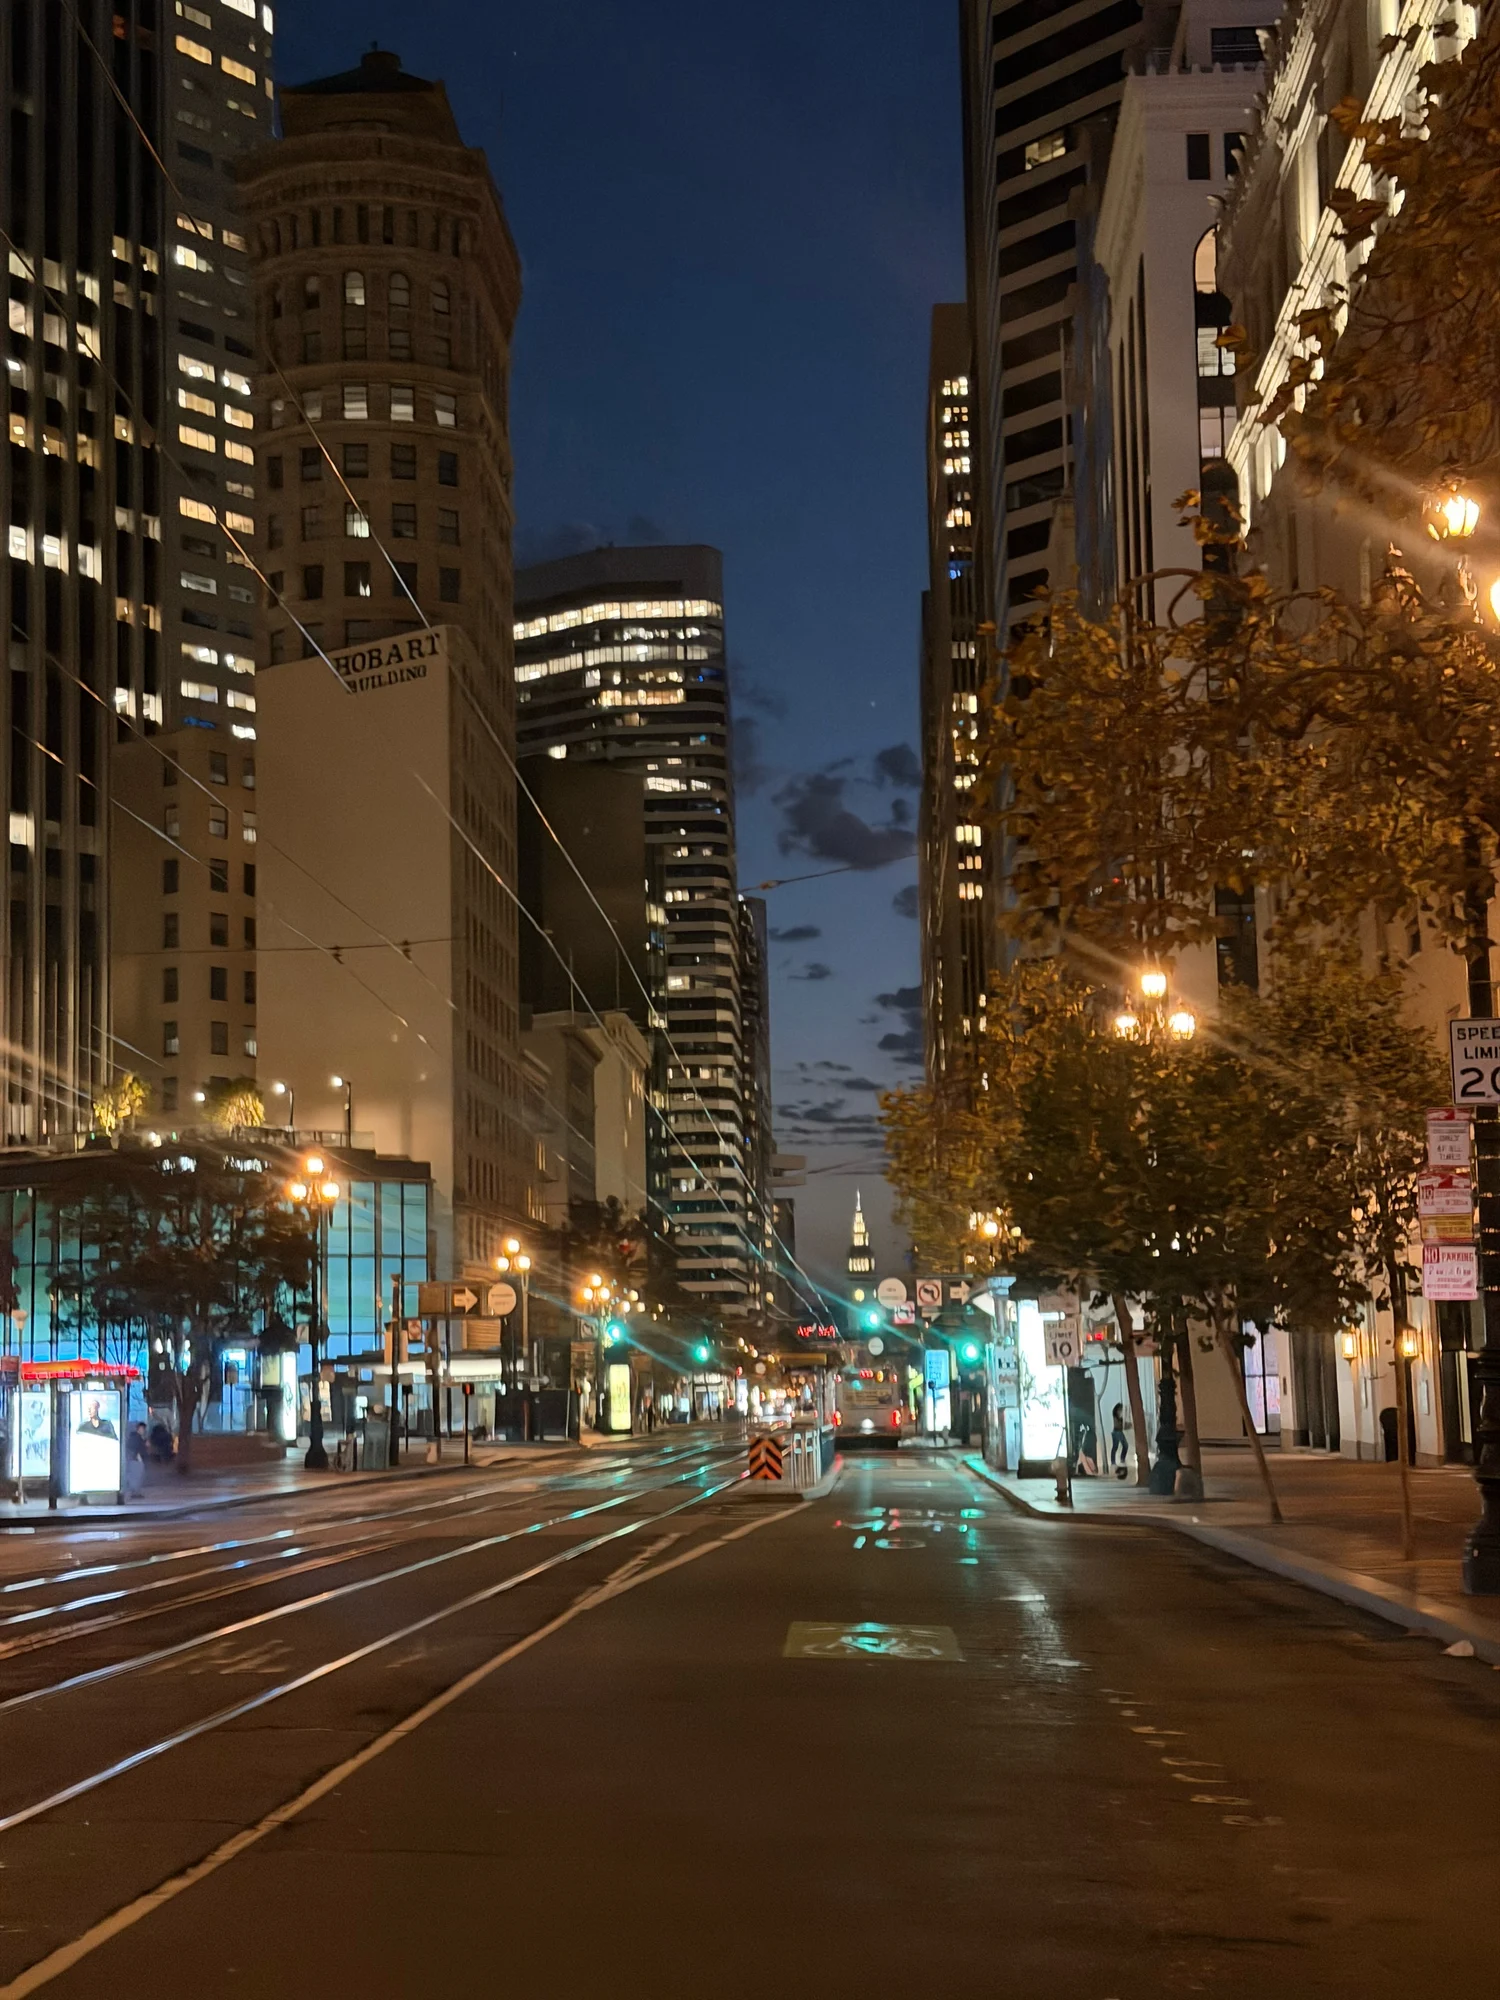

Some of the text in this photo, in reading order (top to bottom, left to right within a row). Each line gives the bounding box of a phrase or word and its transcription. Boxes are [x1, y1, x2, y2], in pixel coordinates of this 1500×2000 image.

[333, 633, 440, 676] HOBART
[345, 664, 427, 694] BUILDING
[1457, 1027, 1500, 1041] SPEE
[1464, 1046, 1500, 1059] LIMI
[1424, 1247, 1474, 1263] NO PARKING
[1052, 1341, 1072, 1358] 10
